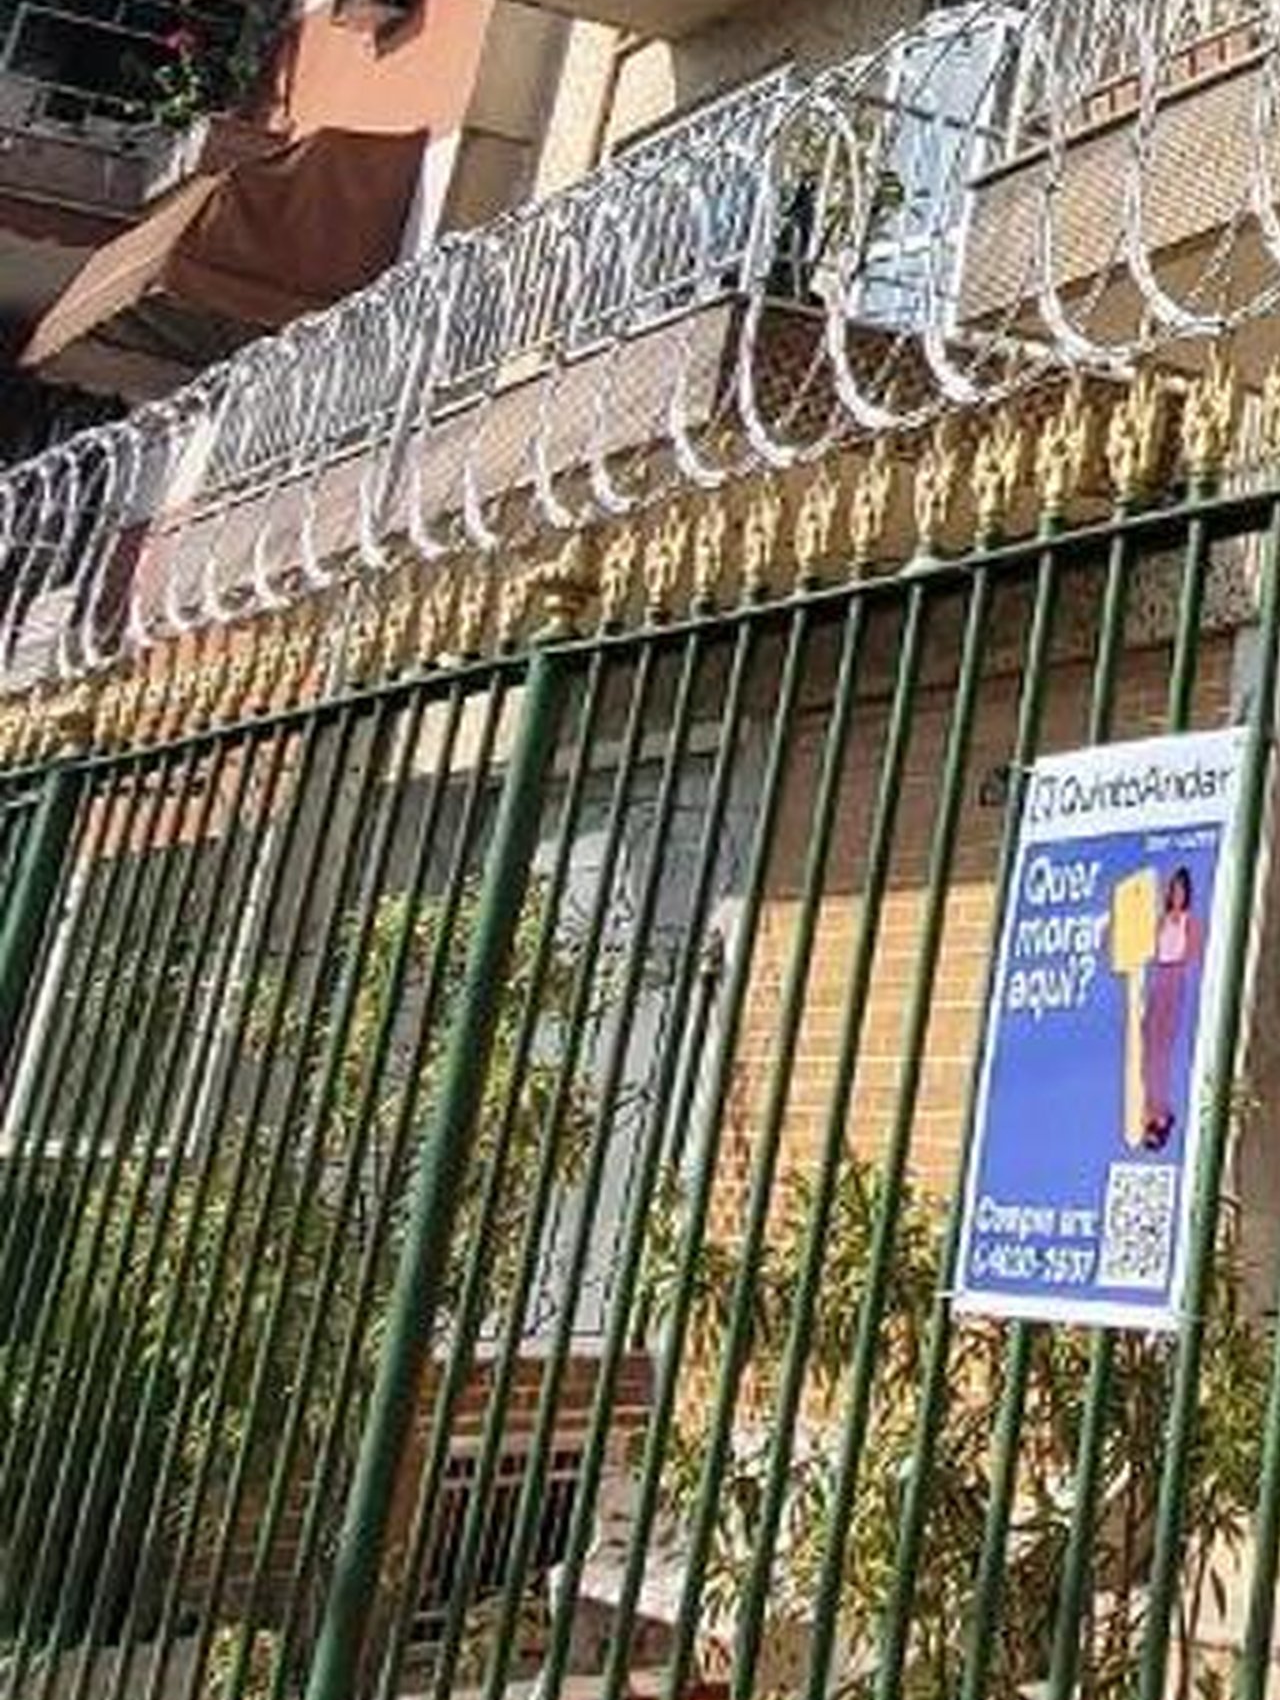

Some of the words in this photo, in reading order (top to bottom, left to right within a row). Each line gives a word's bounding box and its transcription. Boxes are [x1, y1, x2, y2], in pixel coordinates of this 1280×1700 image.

[1059, 756, 1235, 816] QuintoAndar
[1024, 856, 1101, 904] Quer
[1014, 911, 1110, 958] morar
[1007, 955, 1096, 1022] aqui?
